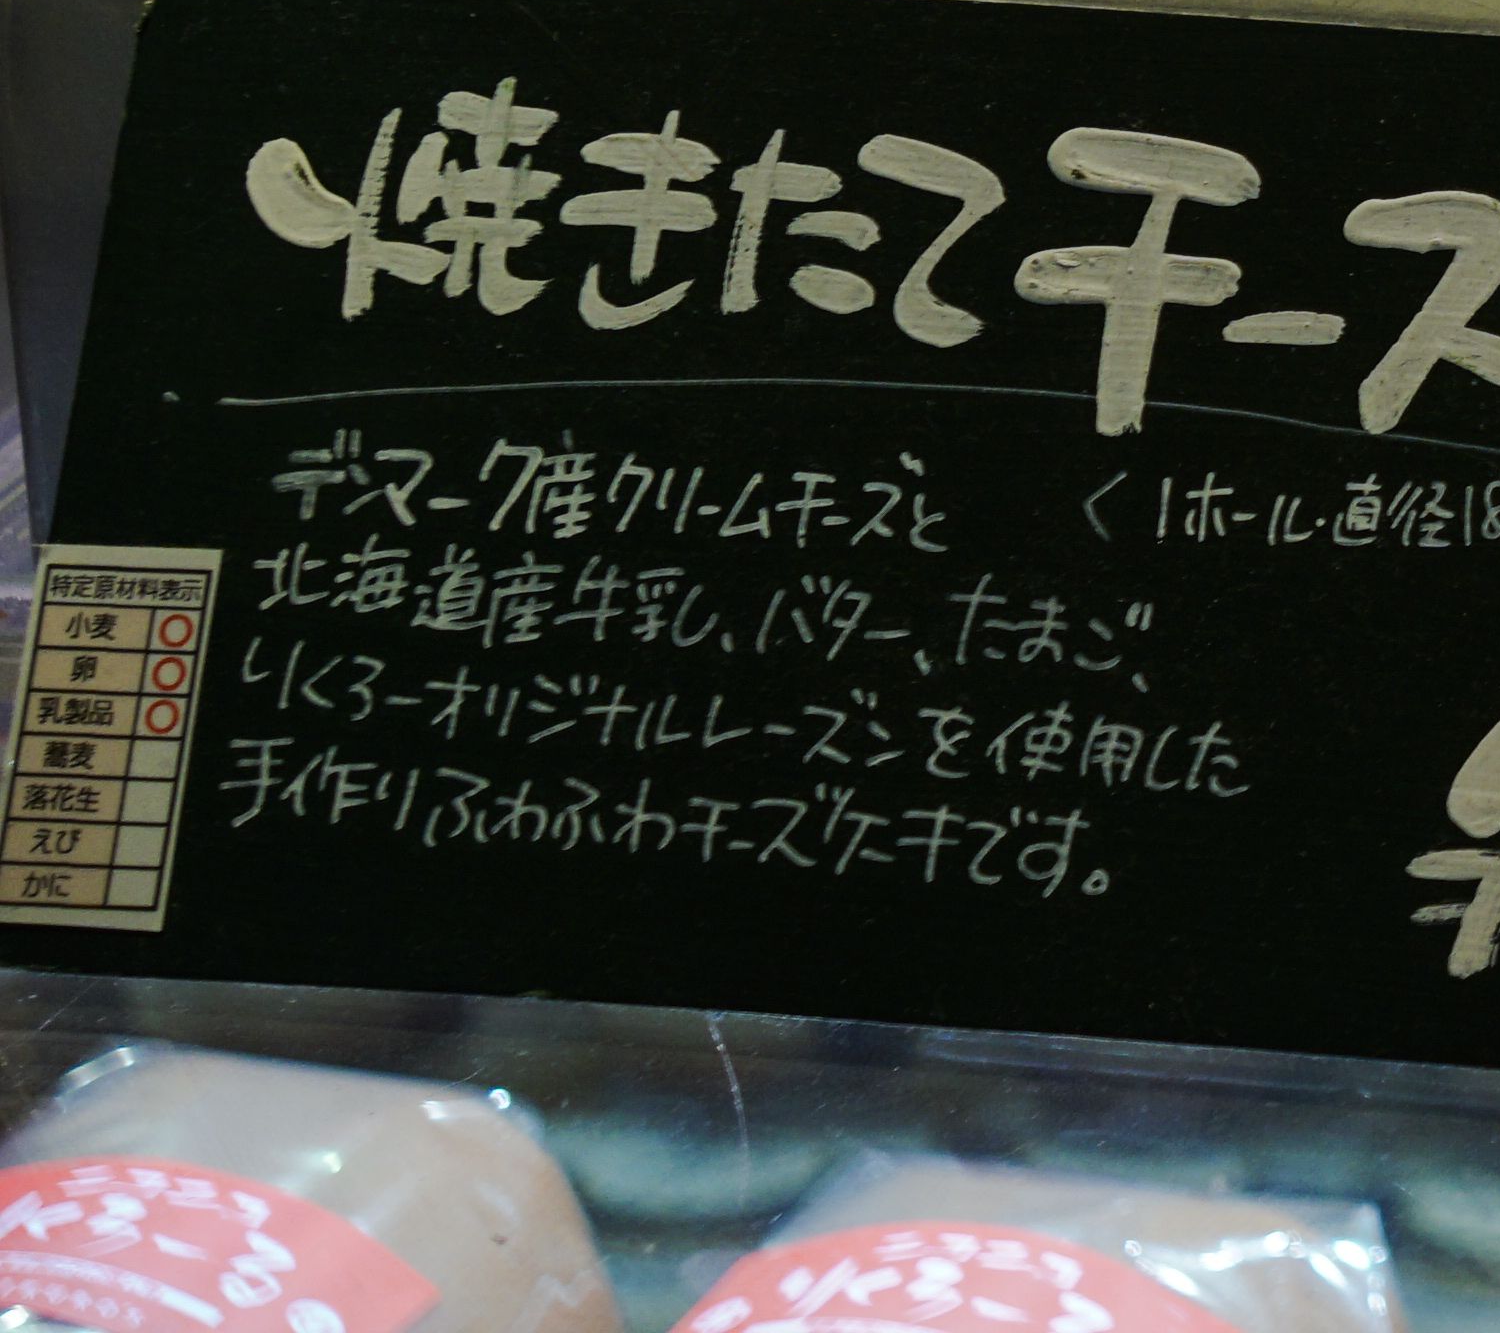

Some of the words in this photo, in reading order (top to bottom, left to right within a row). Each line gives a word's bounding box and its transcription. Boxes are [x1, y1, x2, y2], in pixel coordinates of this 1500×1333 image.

[50, 573, 204, 603] 特定原材料表示
[64, 612, 118, 642] 小麦
[70, 656, 98, 683] 卵
[36, 696, 115, 727] 乳製品
[42, 741, 97, 771] 蕎麦
[22, 784, 101, 815] 落花生
[218, 736, 1112, 900] 手作りふわふわチーズケーキです。
[29, 828, 81, 856] えび
[22, 871, 72, 899] かに
